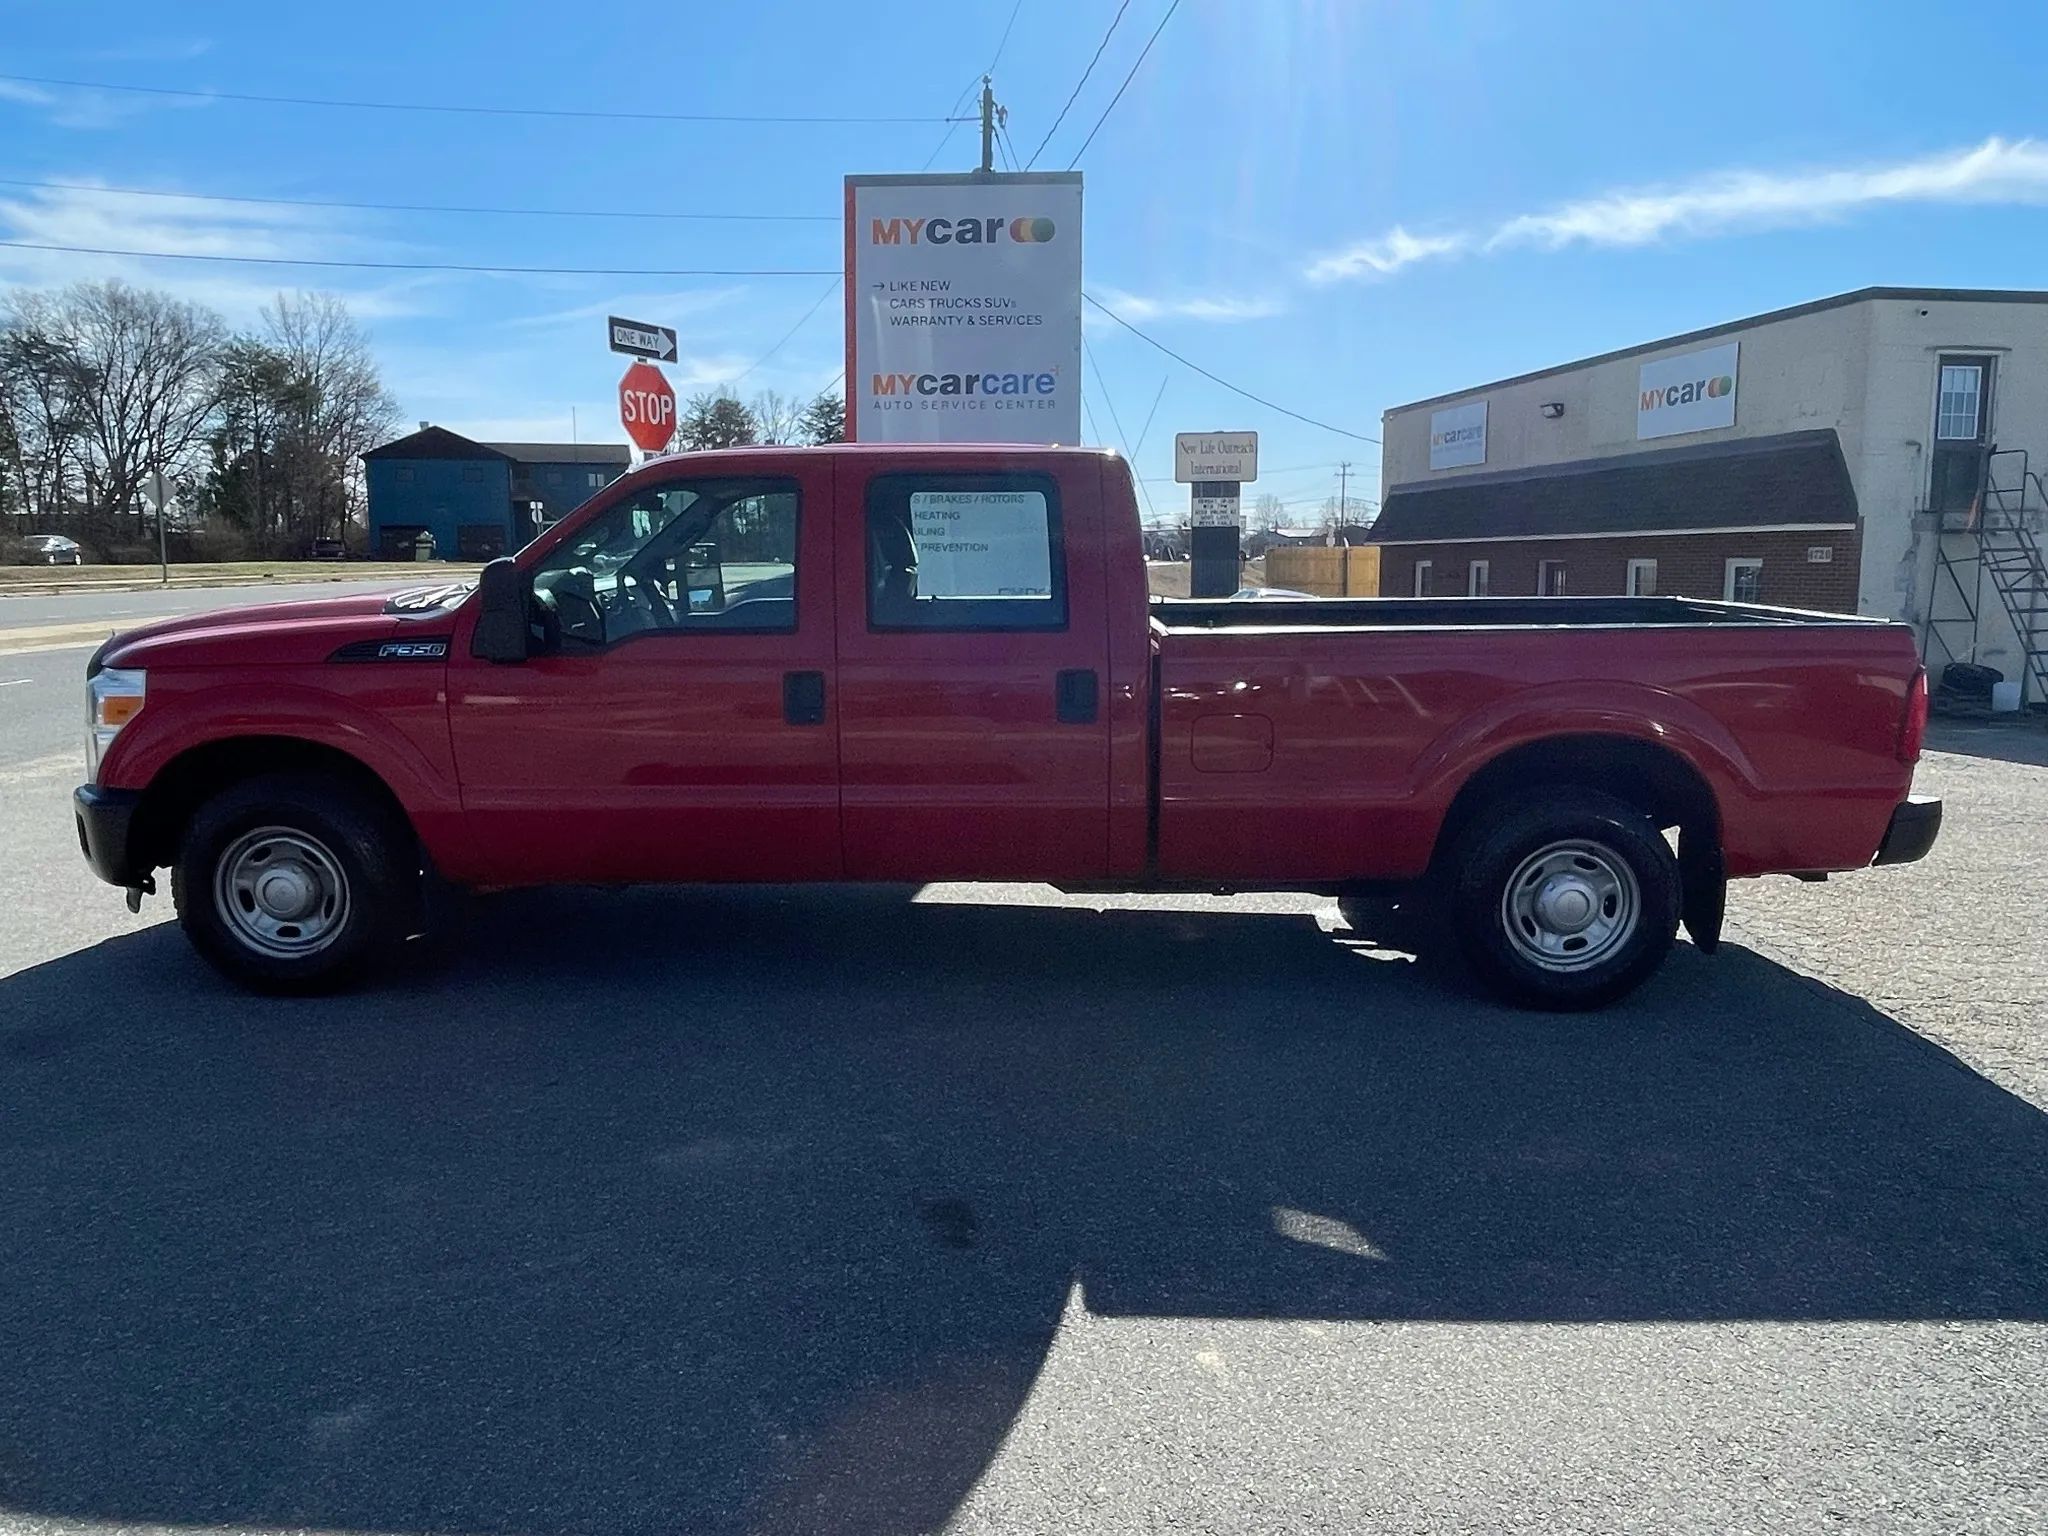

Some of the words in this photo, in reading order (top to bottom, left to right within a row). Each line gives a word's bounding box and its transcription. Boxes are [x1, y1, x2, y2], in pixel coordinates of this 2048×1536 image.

[871, 217, 1004, 245] MYcar
[889, 280, 918, 292] LIKE
[920, 280, 952, 292] NEW
[889, 298, 926, 310] CARS
[929, 298, 982, 309] TRUCKS
[889, 315, 964, 327] WARRANTY
[967, 315, 975, 326] &
[978, 314, 1043, 326] SERVICES
[617, 329, 636, 345] ONE
[639, 333, 660, 350] WAY
[1640, 379, 1706, 411] MYcar
[623, 389, 673, 426] STOP
[872, 400, 914, 411] AUTO
[920, 400, 988, 411] SERVICE
[994, 399, 1057, 411] CENTER
[929, 494, 974, 505] BRAKES
[981, 494, 1025, 505] ROTORS
[914, 510, 961, 521] HEATING
[920, 542, 989, 553] PREVENTION
